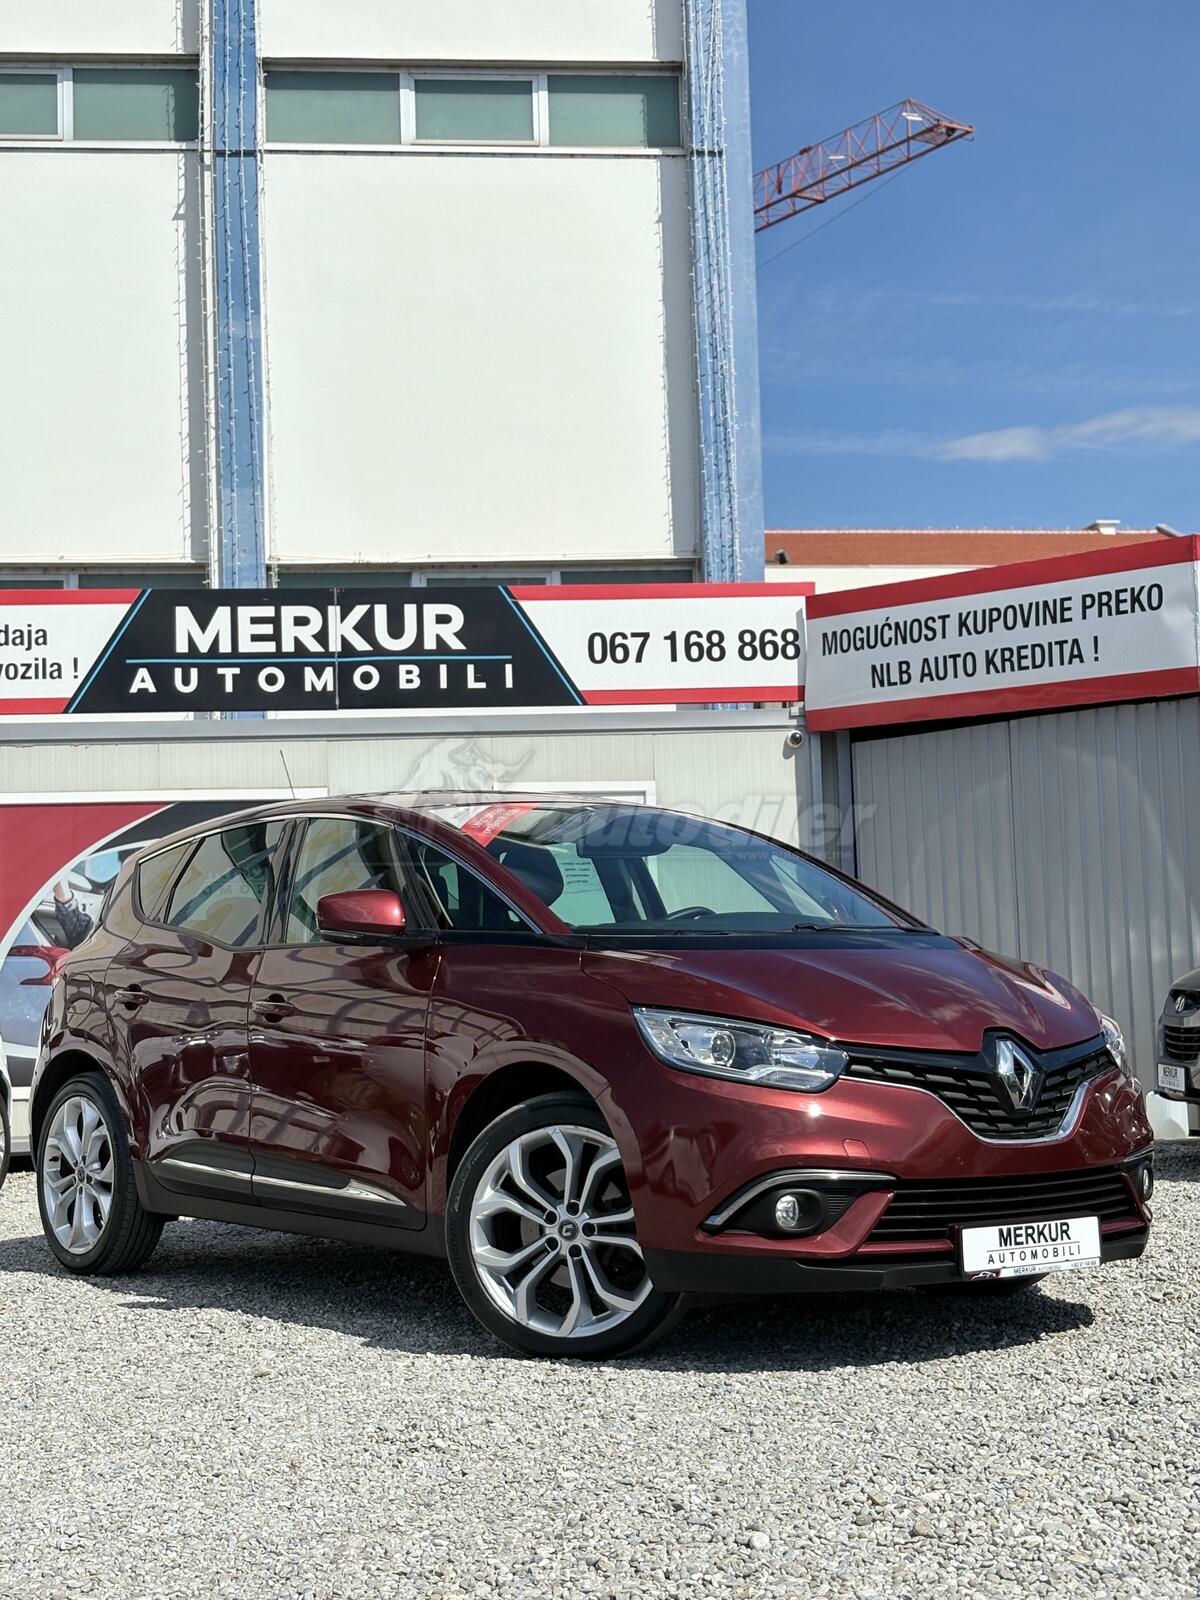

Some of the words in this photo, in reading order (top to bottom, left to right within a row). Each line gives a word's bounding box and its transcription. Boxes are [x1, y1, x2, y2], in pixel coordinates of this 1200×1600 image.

[174, 603, 467, 654] MERKUR
[821, 614, 951, 657] MOGUĆNOST
[958, 596, 1073, 638] KUPOVINE
[1081, 583, 1164, 621] PREKO
[0, 624, 48, 651] daja
[588, 632, 651, 664] 067
[664, 630, 726, 662] 168
[737, 628, 800, 660] 868
[73, 657, 79, 679] !
[871, 660, 912, 689] NLB
[919, 652, 978, 684] AUTO
[985, 638, 1085, 676] KREDITA
[1092, 635, 1100, 663] !
[129, 664, 513, 694] AUTOMOBILI
[998, 1222, 1071, 1248] MERKUR
[987, 1245, 1080, 1265] AUTOMOBILI
